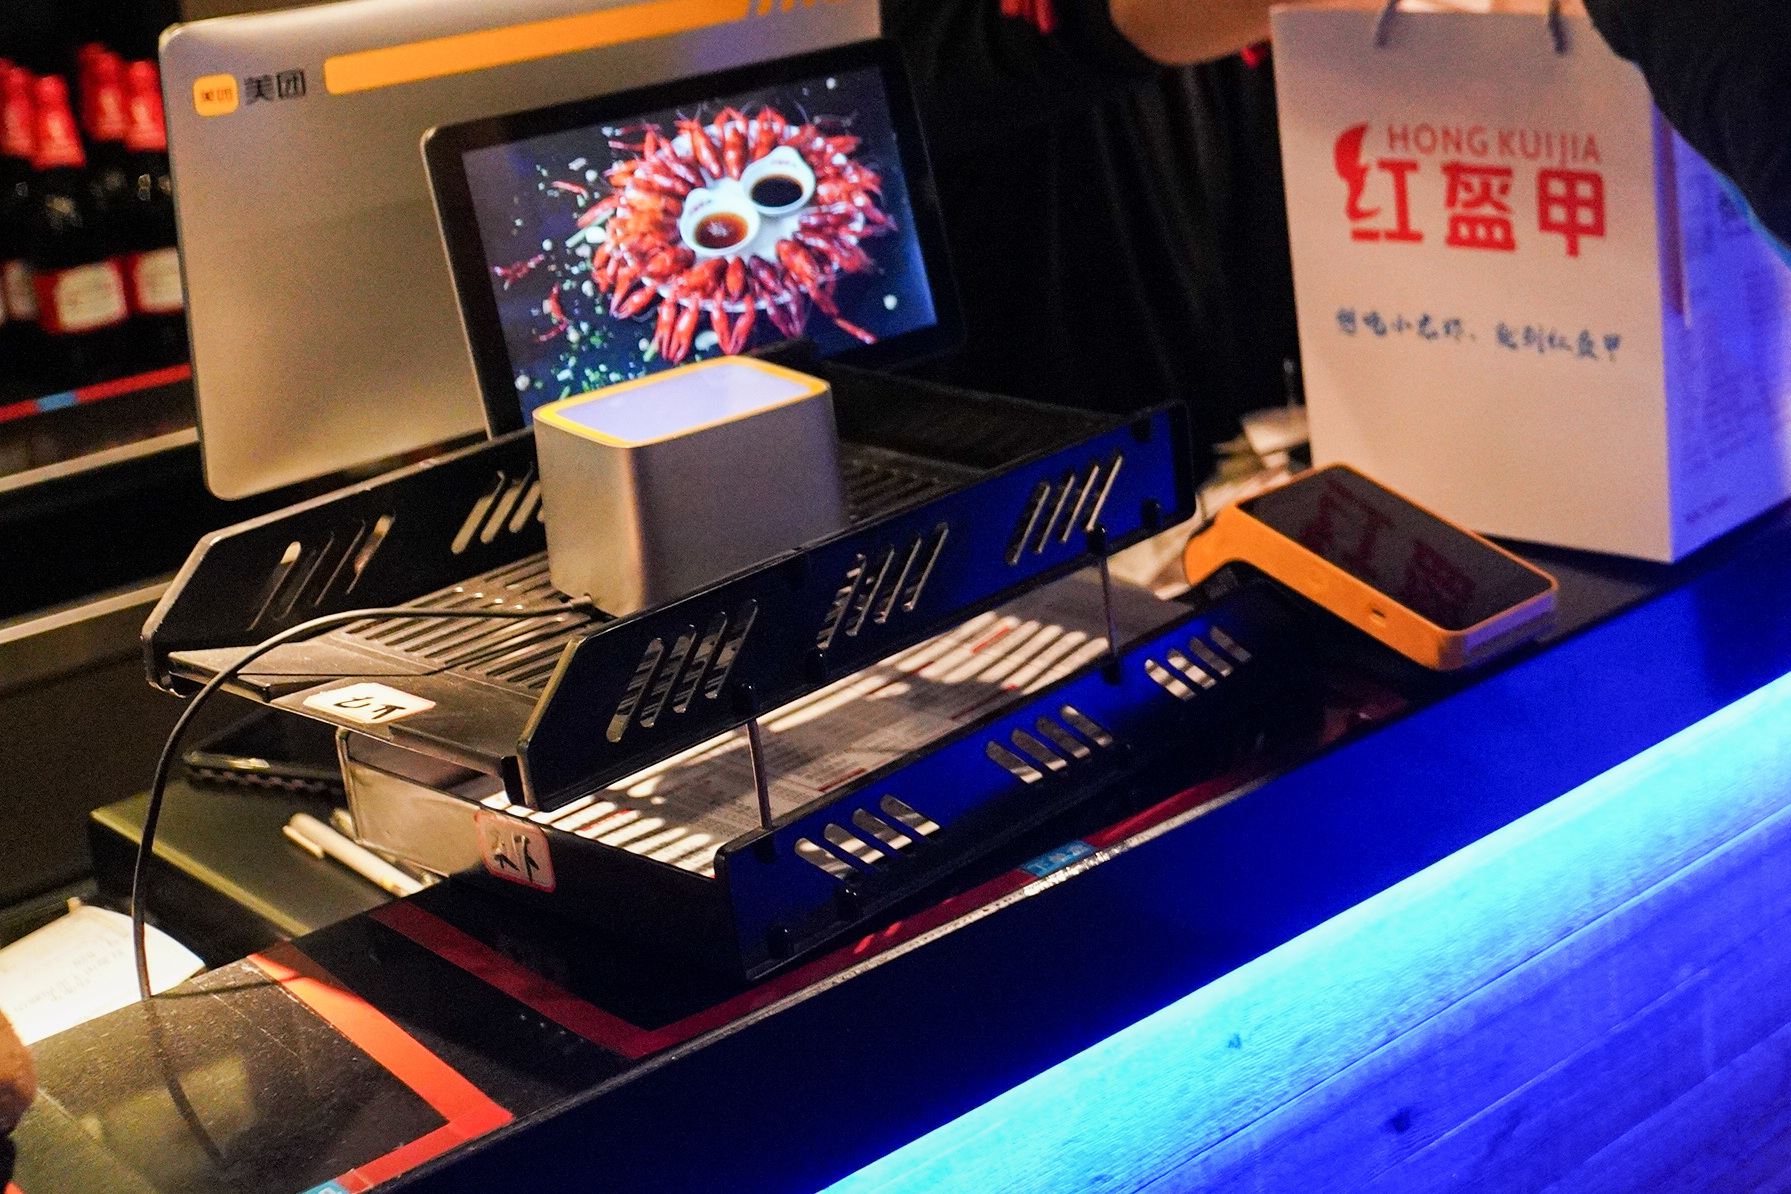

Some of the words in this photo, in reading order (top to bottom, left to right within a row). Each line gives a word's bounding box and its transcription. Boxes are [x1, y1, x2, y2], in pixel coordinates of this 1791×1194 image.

[244, 69, 306, 106] 美团
[1387, 123, 1489, 156] HONG
[1498, 128, 1600, 167] KUIJIA
[1333, 122, 1606, 257] 红盔甲
